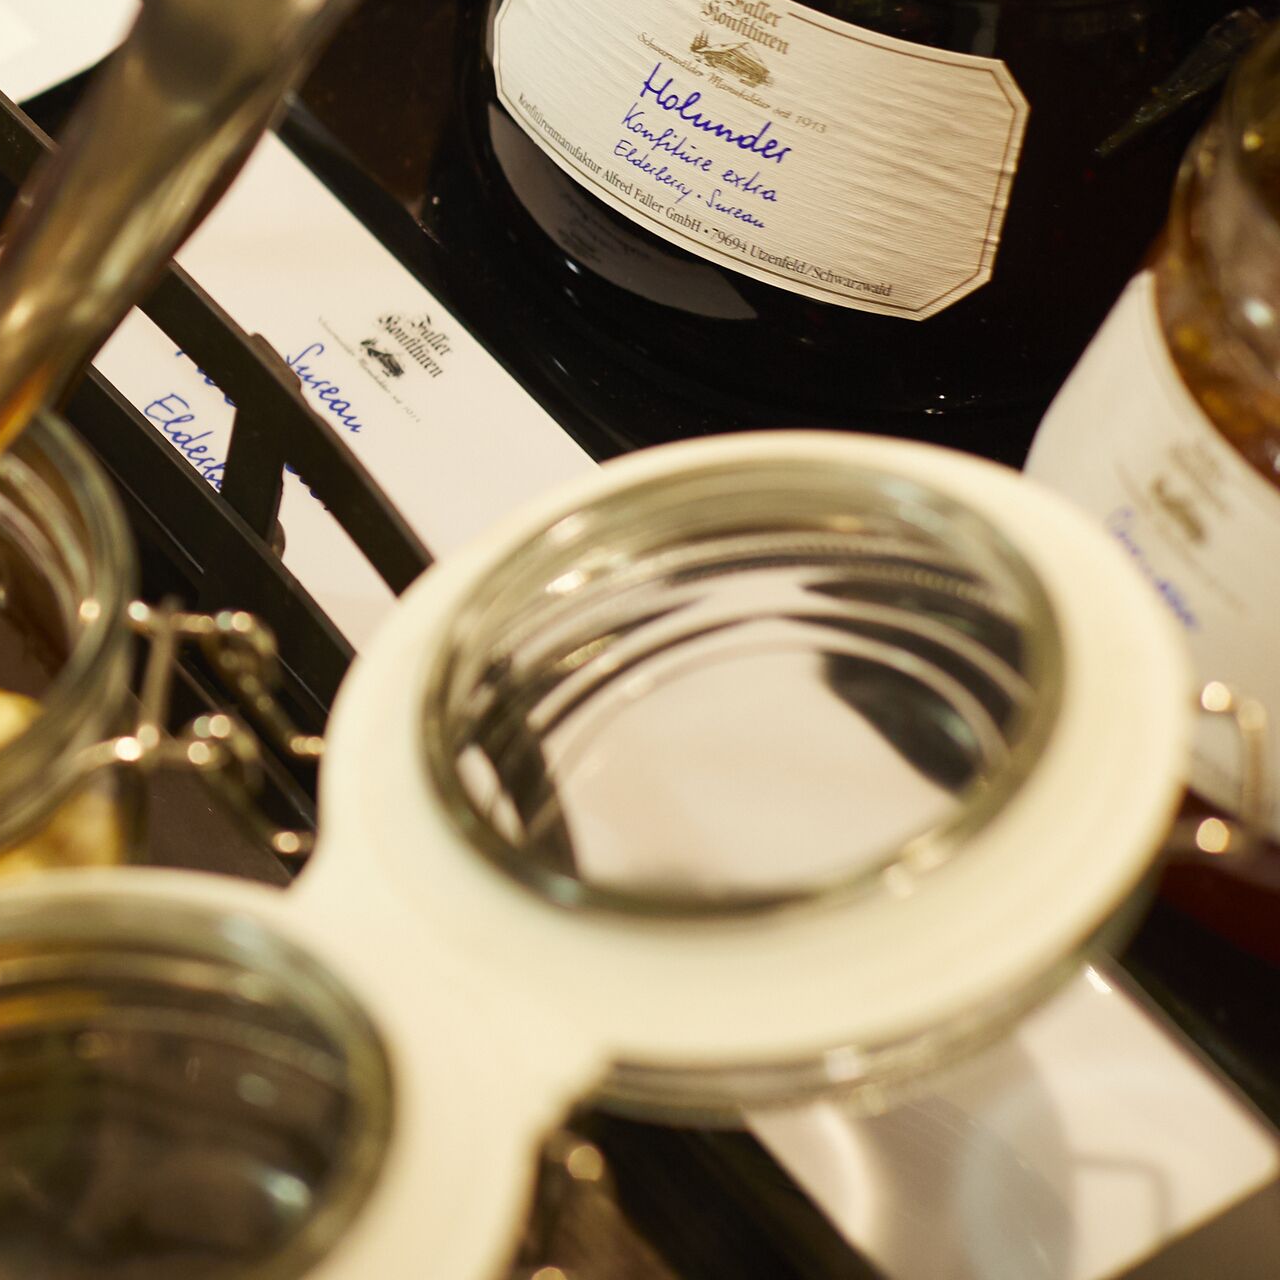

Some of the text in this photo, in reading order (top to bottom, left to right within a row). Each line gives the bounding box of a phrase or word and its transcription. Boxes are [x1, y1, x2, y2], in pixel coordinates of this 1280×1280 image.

[622, 102, 778, 202] Konfitüre extra
[639, 62, 792, 164] Holunder
[603, 169, 634, 195] Alfred
[633, 188, 664, 214] Faller
[666, 206, 702, 233] GmbH
[712, 227, 748, 253] 79694
[613, 139, 693, 205] Elderberry
[705, 188, 766, 229] Sureau
[286, 342, 363, 434] Sureau
